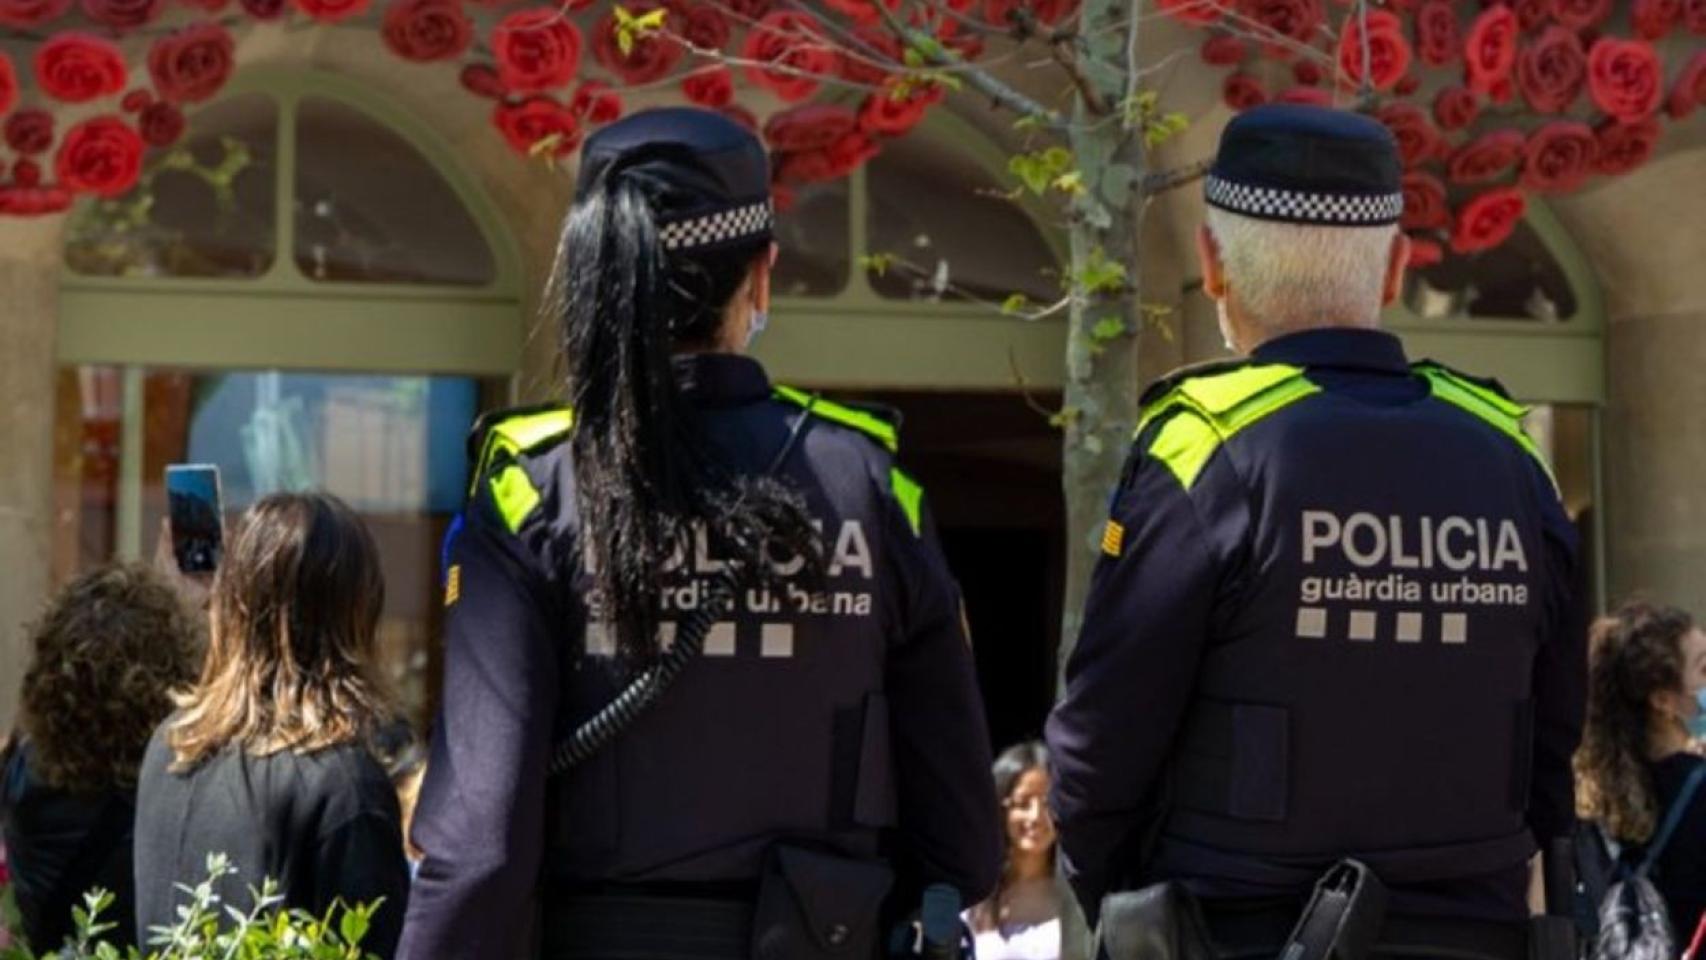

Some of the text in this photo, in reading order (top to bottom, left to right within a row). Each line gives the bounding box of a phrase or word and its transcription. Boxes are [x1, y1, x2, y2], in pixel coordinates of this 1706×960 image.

[1302, 510, 1528, 572] POLICIA
[1301, 572, 1528, 605] guàrdia urbana
